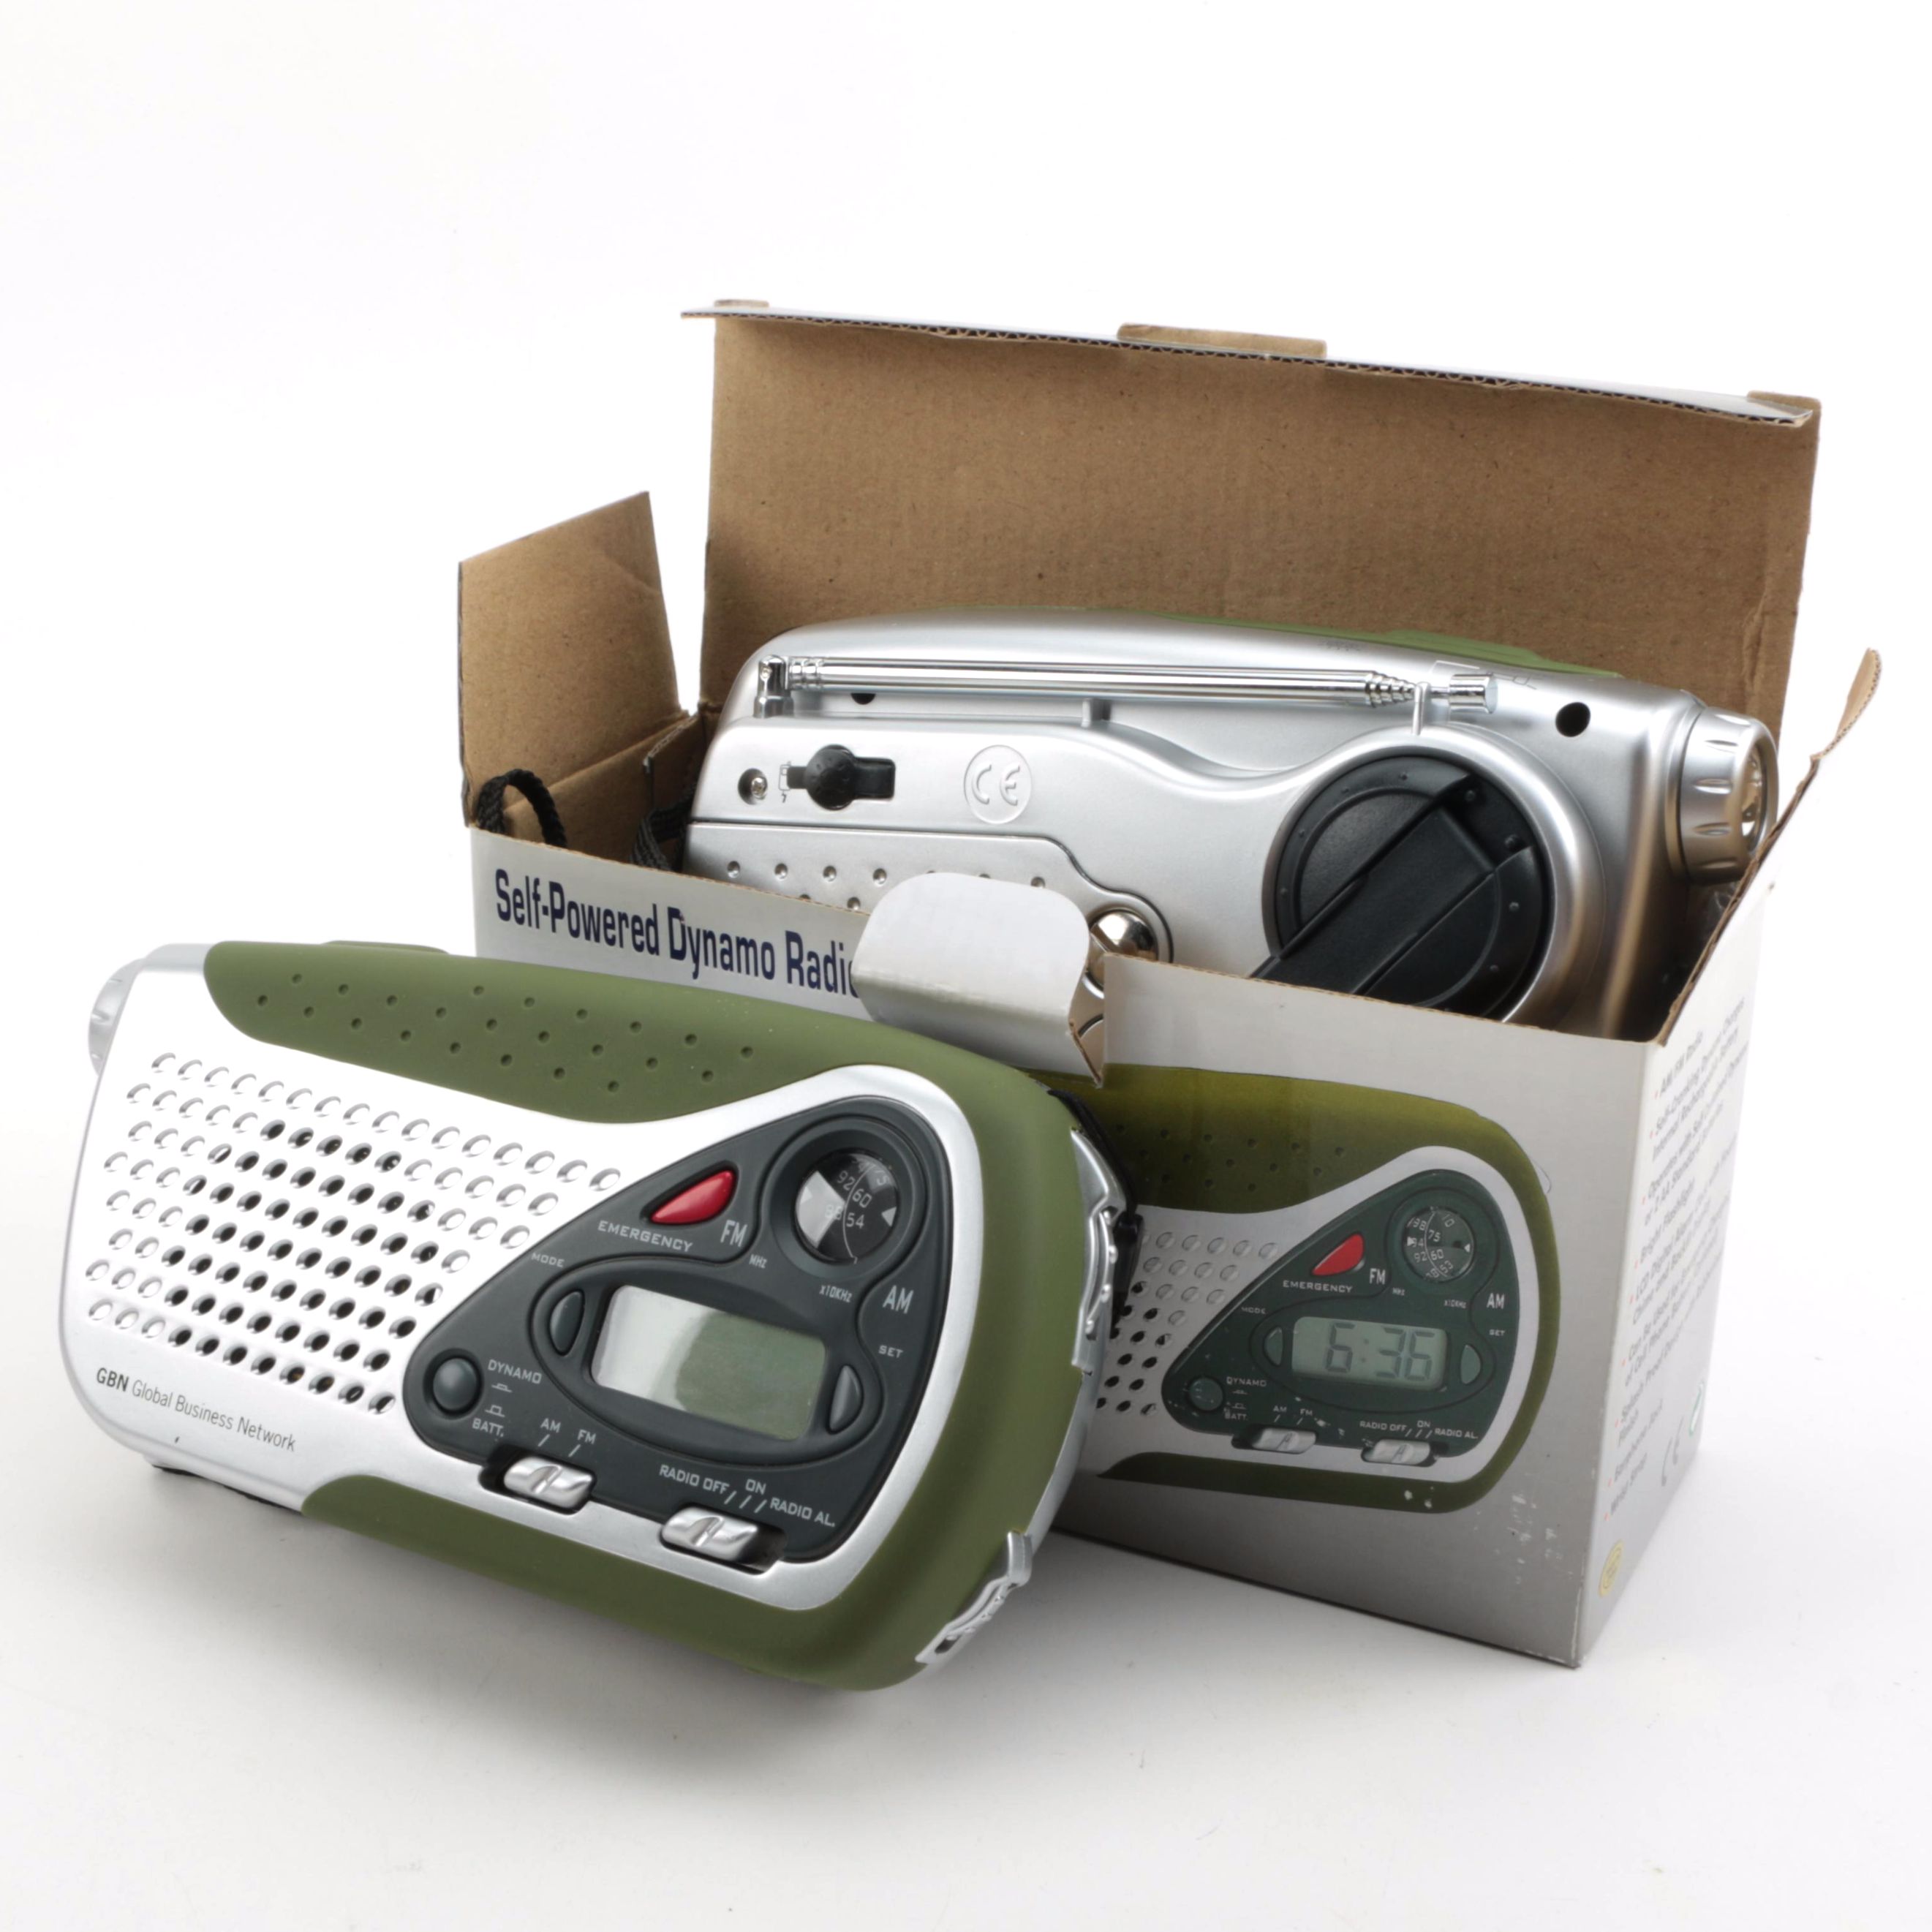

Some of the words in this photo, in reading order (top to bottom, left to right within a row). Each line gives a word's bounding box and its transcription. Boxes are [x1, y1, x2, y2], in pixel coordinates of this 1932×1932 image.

[495, 869, 659, 956] Self-Powered
[668, 907, 775, 981] Dynamo
[837, 1171, 856, 1190] 92
[852, 1188, 872, 1208] 60
[846, 1212, 865, 1229] 54
[597, 1220, 693, 1253] EMERGENCY
[720, 1219, 749, 1248] FM
[1427, 1229, 1441, 1242] 75
[531, 1251, 565, 1268] MODE
[1414, 1251, 1427, 1263] 92
[1430, 1249, 1444, 1261] 60
[1369, 1267, 1386, 1286] FM
[1283, 1280, 1353, 1293] EMERGENCY
[883, 1285, 914, 1314] AM
[1486, 1292, 1506, 1310] AM
[1489, 1329, 1506, 1337] SET
[878, 1345, 904, 1358] SET
[487, 1358, 542, 1385] DYNAMO
[1226, 1376, 1267, 1387] DYNAMO
[96, 1367, 129, 1392] GBN
[132, 1379, 173, 1408] Global
[175, 1395, 233, 1430] Business
[237, 1416, 296, 1452] Network
[1272, 1405, 1287, 1413] AM
[1299, 1408, 1313, 1416] FM
[472, 1417, 505, 1438] BATT.
[540, 1416, 562, 1434] AM
[1359, 1420, 1388, 1430] RADIO
[1389, 1423, 1407, 1432] OFF
[1416, 1420, 1431, 1428] ON
[1434, 1427, 1463, 1438] RADIO
[577, 1428, 597, 1445] FM
[659, 1464, 701, 1488] RADIO
[703, 1476, 731, 1495] OFF
[745, 1478, 767, 1495] ON
[769, 1497, 812, 1522] RADIO
[815, 1509, 837, 1528] AL.
